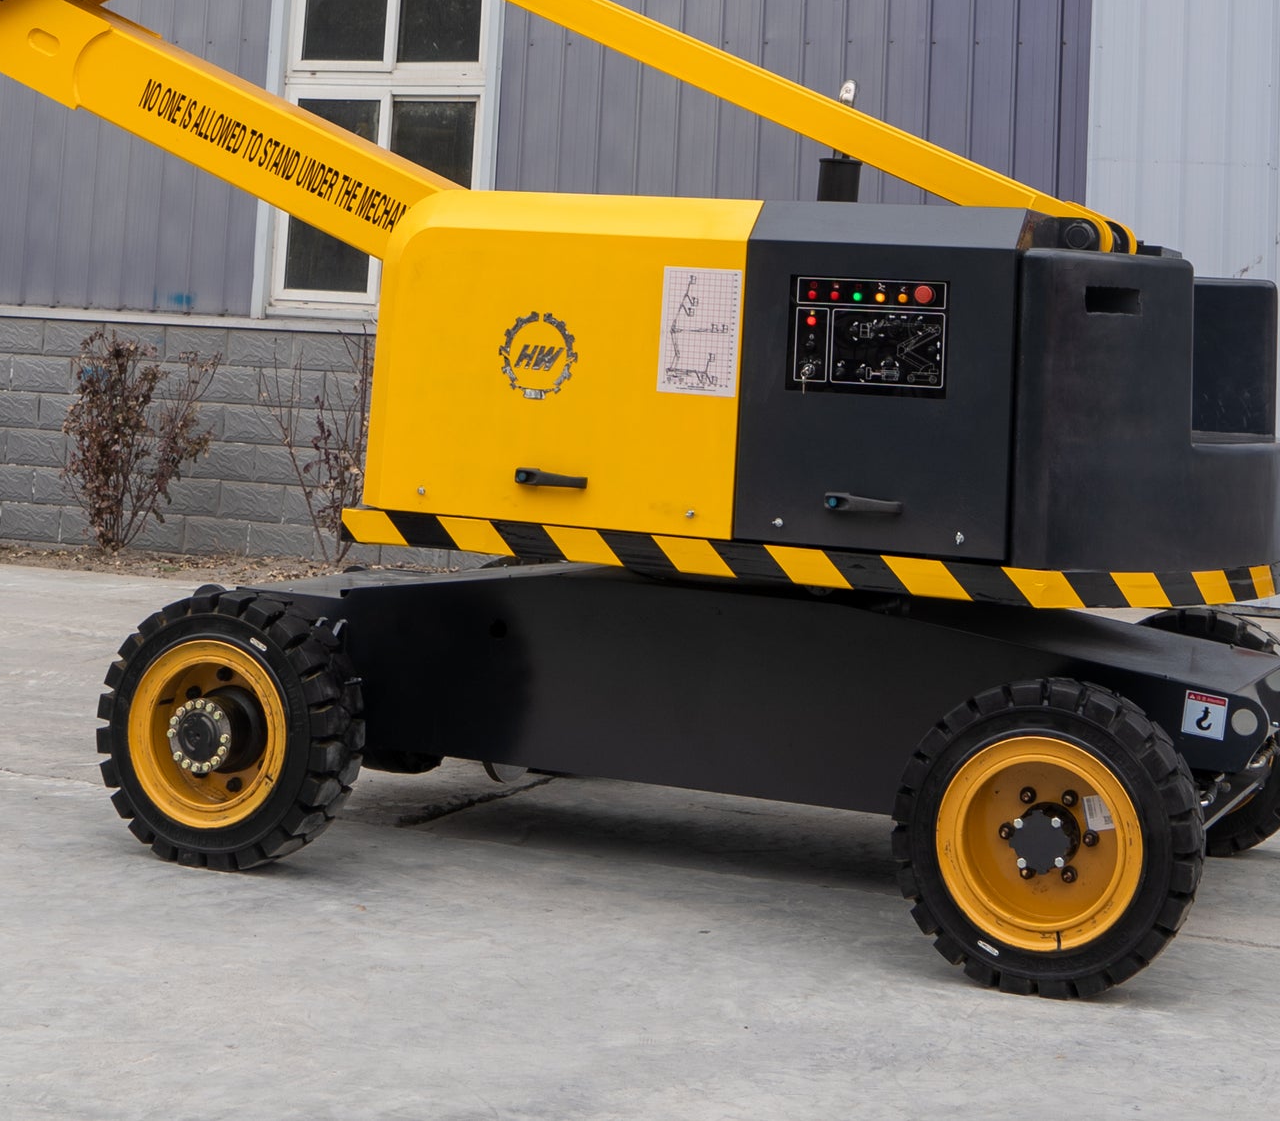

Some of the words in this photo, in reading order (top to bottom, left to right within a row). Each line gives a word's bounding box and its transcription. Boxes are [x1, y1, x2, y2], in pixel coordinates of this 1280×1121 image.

[138, 78, 162, 112] NO
[157, 87, 187, 125] ONE
[178, 98, 198, 130] IS
[190, 105, 247, 154] ALLOWED
[242, 128, 264, 163] TO
[258, 137, 301, 181] STAND
[295, 155, 340, 201] UNDER
[334, 174, 363, 213] THE
[514, 344, 565, 371] HW
